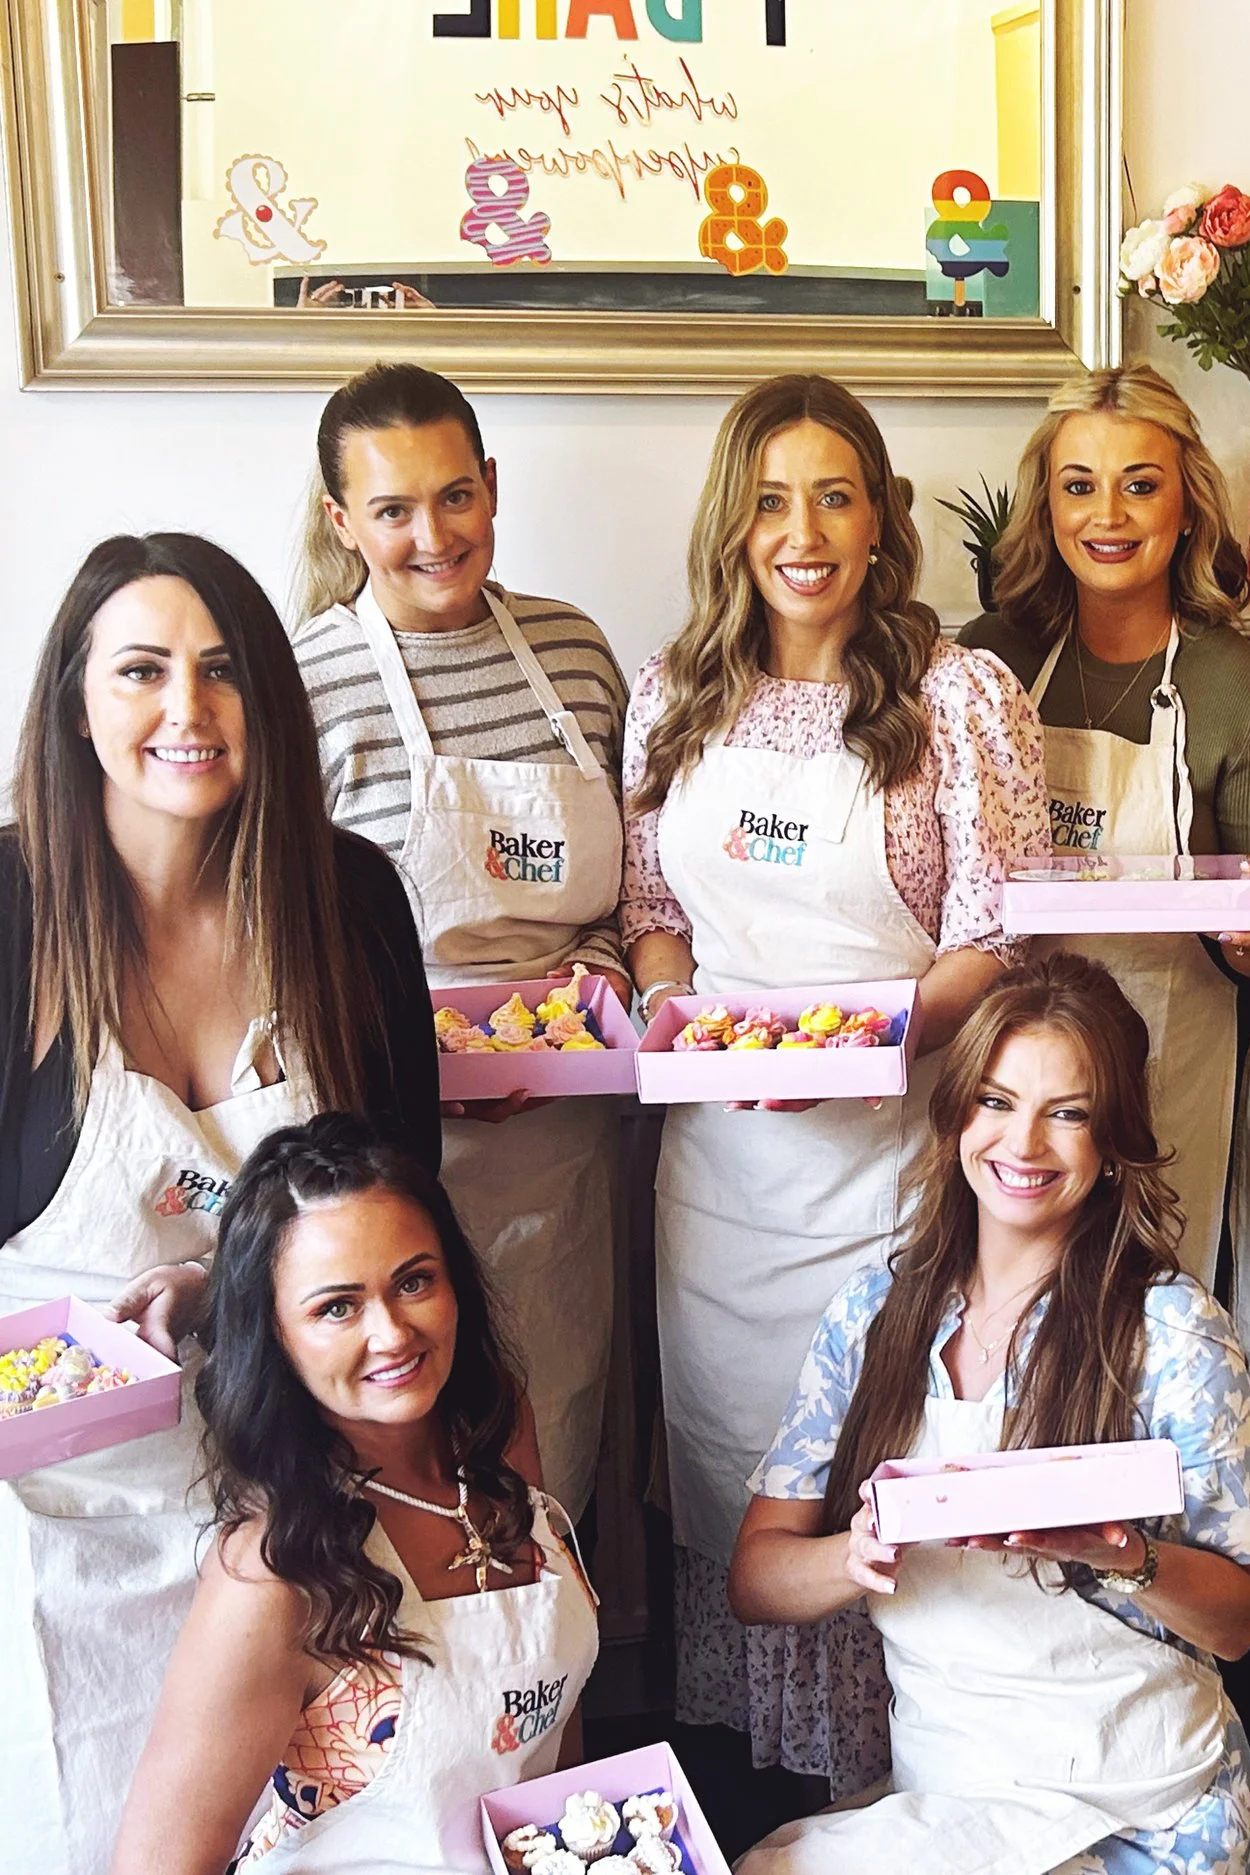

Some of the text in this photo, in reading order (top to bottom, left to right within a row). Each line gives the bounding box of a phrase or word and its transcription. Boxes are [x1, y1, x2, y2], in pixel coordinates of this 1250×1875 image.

[739, 809, 809, 841] Baker
[1050, 799, 1107, 828] Baker
[490, 830, 565, 859] Baker
[1053, 824, 1104, 850] Chef
[177, 1170, 233, 1197] Bak
[502, 1673, 568, 1718] Baker
